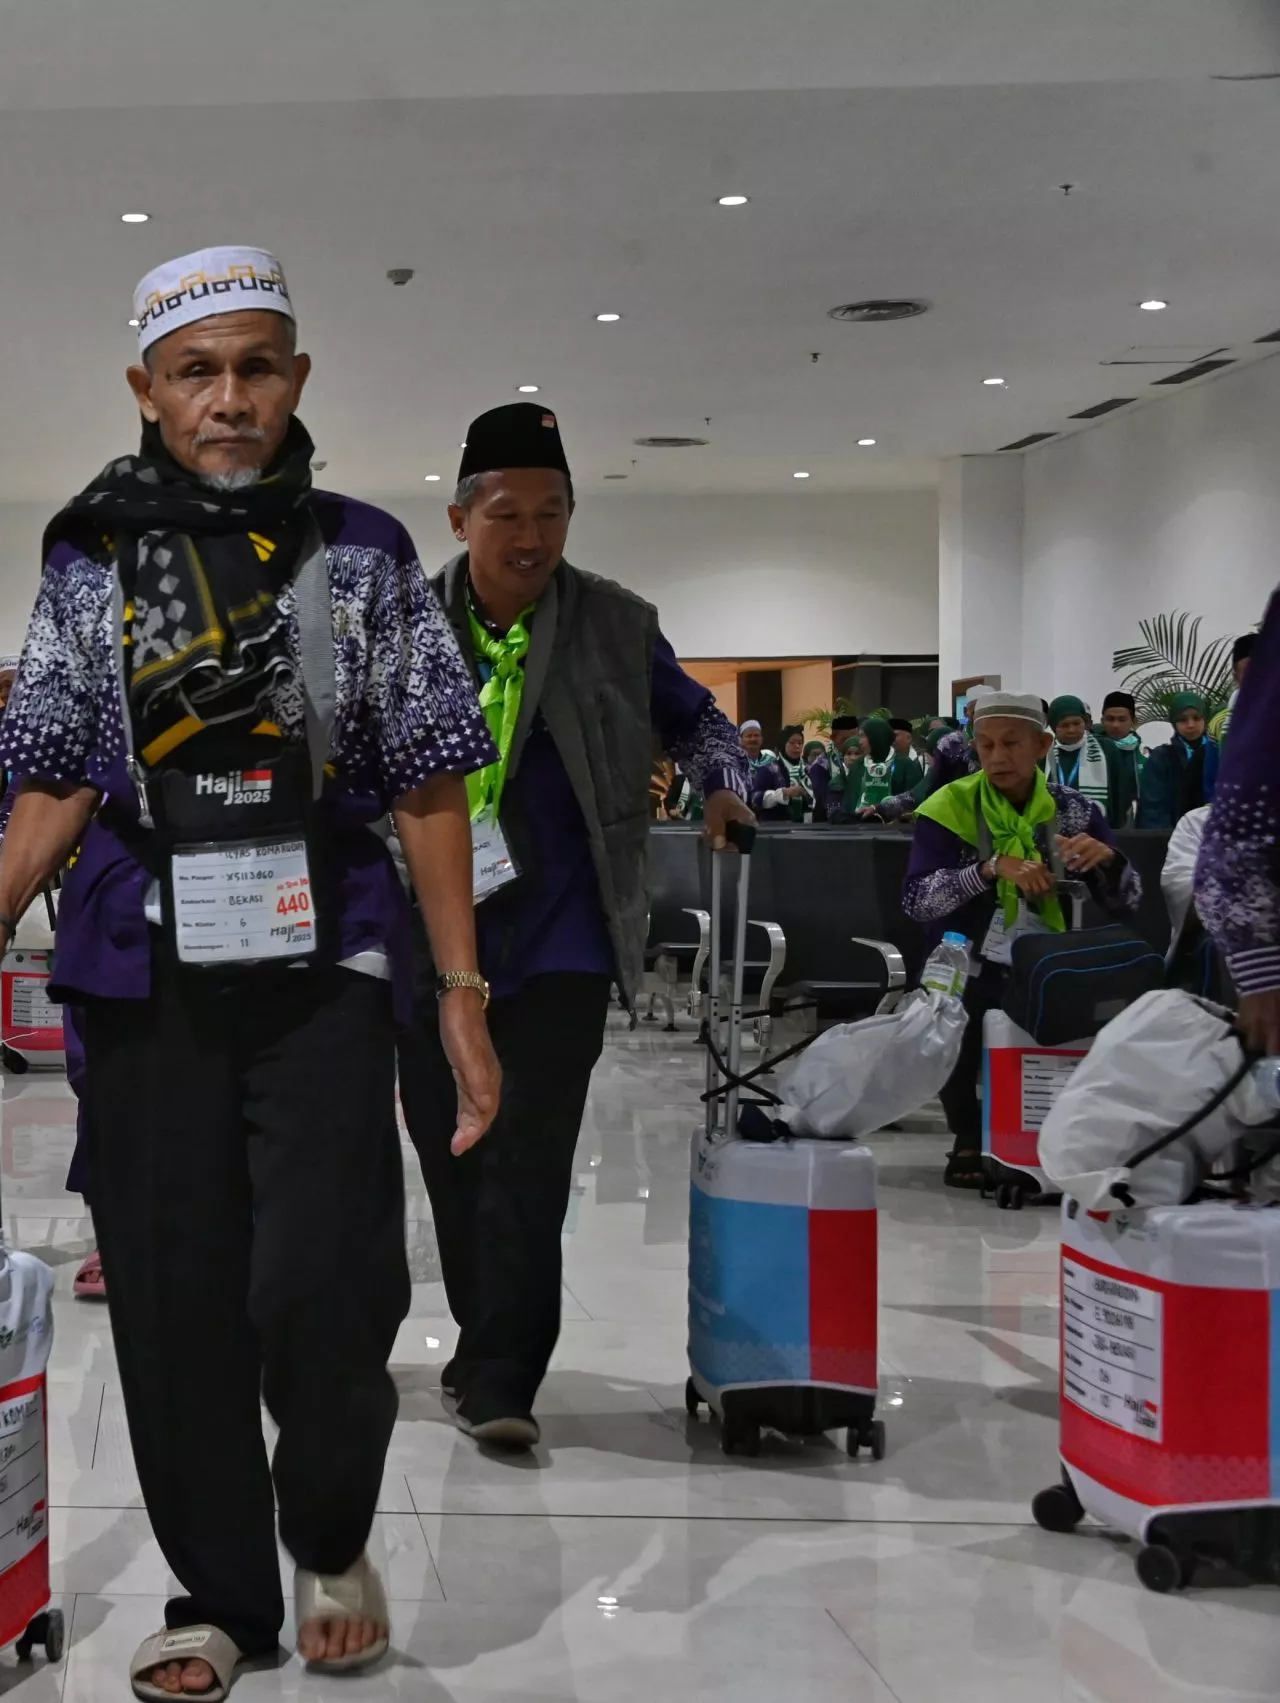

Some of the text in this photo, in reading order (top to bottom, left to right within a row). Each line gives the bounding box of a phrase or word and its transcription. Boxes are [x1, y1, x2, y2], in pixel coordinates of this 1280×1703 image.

[196, 770, 241, 806] Haji
[233, 790, 271, 804] 2025
[276, 891, 309, 916] 440
[270, 923, 295, 943] Haji
